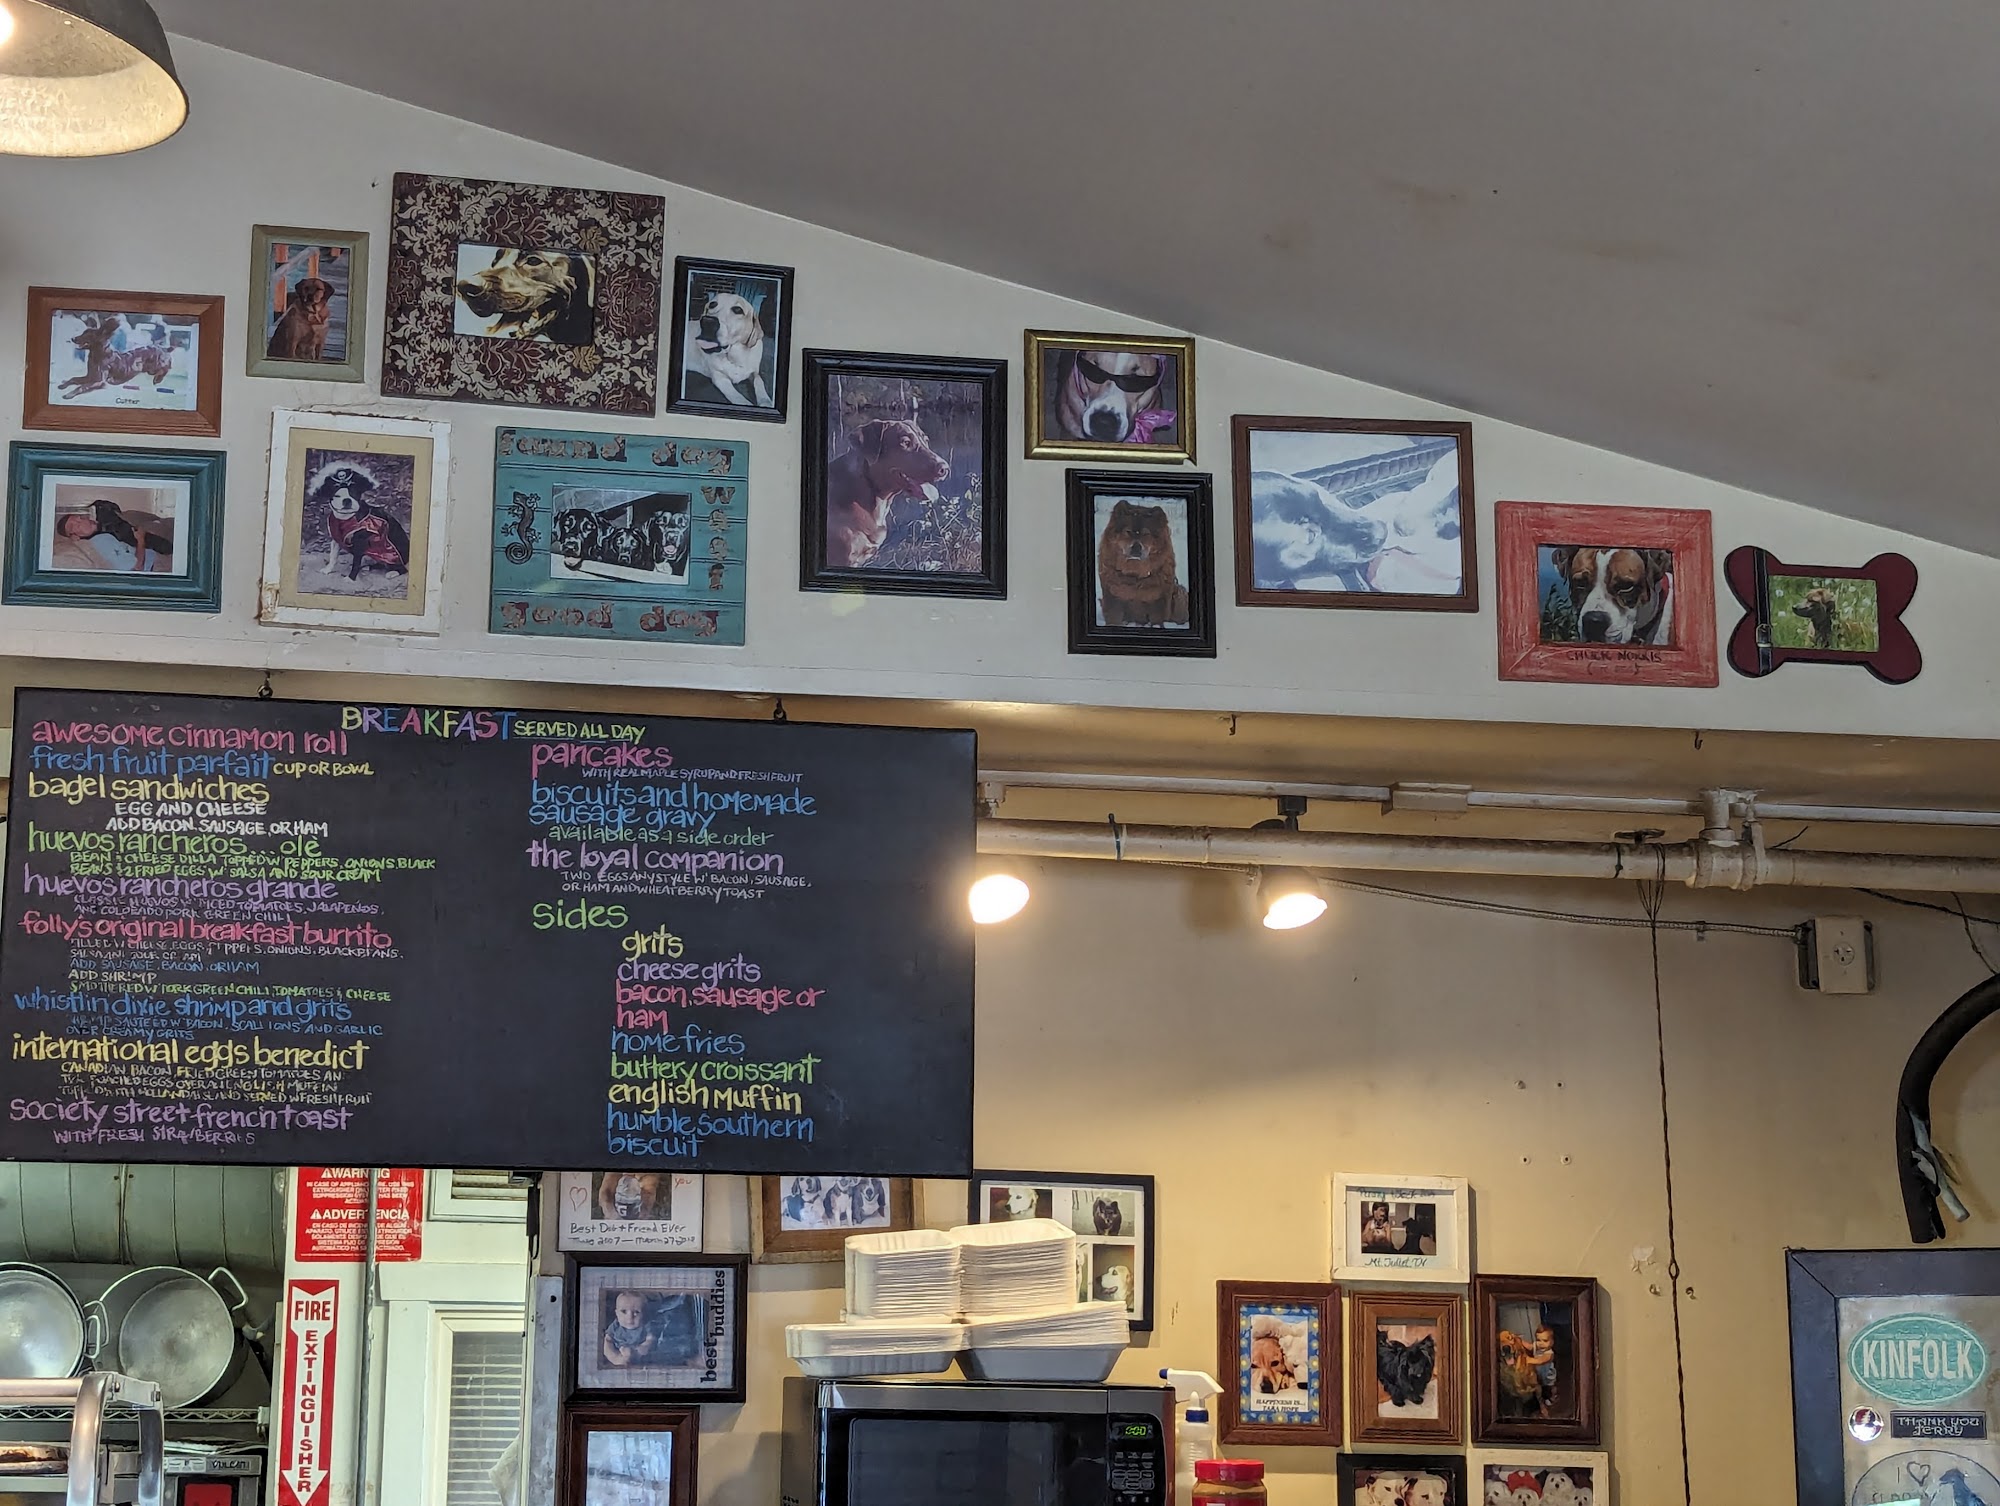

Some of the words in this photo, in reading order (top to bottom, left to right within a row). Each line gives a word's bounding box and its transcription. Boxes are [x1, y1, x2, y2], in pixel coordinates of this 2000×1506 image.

[652, 440, 735, 475] dog
[640, 605, 719, 636] dog
[32, 720, 165, 747] awesome
[168, 723, 294, 754] cinnamon
[304, 730, 348, 755] roll
[341, 706, 518, 742] BREAKFAST
[514, 720, 578, 737] SERVED
[580, 722, 609, 738] ALL
[610, 724, 646, 744] DAY
[30, 744, 105, 774] fresh
[108, 746, 173, 777] fruit
[177, 750, 275, 782] parfait
[273, 761, 306, 779] CUP
[309, 762, 331, 776] OR
[332, 762, 374, 777] BOWL
[531, 742, 673, 780] pancakes
[581, 767, 612, 782] WITH
[613, 768, 641, 779] REAL
[641, 768, 679, 780] MAPLE
[679, 769, 715, 782] SYRUP
[714, 770, 738, 781] AND
[738, 770, 771, 782] FRESH
[771, 771, 804, 783] FRUIT
[29, 771, 106, 806] bagel
[110, 773, 270, 805] sandwiches
[531, 780, 635, 807] biscuits
[637, 782, 688, 809] and
[693, 781, 817, 816] homemade
[115, 802, 153, 816] EGG
[156, 802, 193, 817] AND
[196, 802, 267, 818] CHEESE
[528, 804, 642, 834] sausage
[645, 807, 716, 840] gravy
[28, 821, 116, 853] huevos
[105, 817, 141, 832] ADD
[270, 820, 291, 836] OR
[293, 820, 328, 838] HAM
[549, 824, 636, 844] available
[637, 827, 660, 843] as
[662, 829, 673, 845] a
[676, 829, 721, 846] side
[723, 826, 775, 847] order
[70, 852, 112, 865] BEAN
[124, 853, 176, 865] CHEESE
[397, 858, 436, 869] BLACK
[135, 864, 171, 878] FRIED
[229, 867, 266, 879] SALSA
[269, 867, 298, 879] AND
[301, 868, 336, 881] SOUR
[525, 838, 575, 870] the
[580, 842, 639, 882] loyal
[644, 849, 785, 877] companion
[24, 862, 117, 896] huevos
[120, 873, 244, 899] rancheros
[246, 877, 339, 904] grande
[560, 882, 582, 893] OR
[583, 883, 611, 894] HAM
[611, 884, 636, 895] AND
[722, 887, 766, 900] TOAST
[597, 871, 629, 883] EGGS
[629, 871, 655, 885] ANY
[655, 872, 691, 887] STYLE
[18, 911, 93, 941] folly's
[94, 914, 184, 944] original
[190, 918, 302, 947] breakfast
[303, 920, 393, 949] burrito
[621, 923, 684, 962] grits
[68, 968, 98, 980] ADD
[617, 959, 700, 983] cheese
[701, 952, 762, 993] grits
[111, 990, 171, 1016] dixie
[174, 996, 247, 1024] shrimp
[249, 996, 293, 1018] and
[295, 996, 352, 1024] grits
[193, 982, 236, 996] GREEN
[346, 987, 392, 1002] CHEESE
[692, 985, 795, 1015] sausage
[795, 986, 827, 1008] or
[304, 1022, 332, 1035] AND
[616, 1003, 669, 1035] ham
[12, 1030, 179, 1064] international
[184, 1038, 250, 1072] eggs
[254, 1035, 370, 1071] benedict
[610, 1026, 676, 1055] home
[678, 1023, 746, 1056] fries
[610, 1050, 699, 1088] buttery
[700, 1052, 822, 1085] croissant
[608, 1077, 710, 1116] english
[712, 1083, 802, 1116] muffin
[113, 1098, 190, 1125] street
[189, 1103, 278, 1130] french
[278, 1103, 354, 1131] toast
[606, 1101, 697, 1136] humble
[696, 1110, 815, 1143] southern
[54, 1129, 94, 1144] WITH
[606, 1130, 705, 1159] biscuit
[570, 1222, 597, 1234] Best
[627, 1222, 659, 1234] Friend
[294, 1300, 331, 1321] FIRE
[710, 1269, 726, 1337] buddies
[700, 1337, 718, 1383] best
[1862, 1339, 1975, 1380] KINFOLK
[297, 1329, 319, 1493] EXTINGUISHER
[1896, 1416, 1947, 1428] THANK
[1950, 1416, 1980, 1428] YOU
[1912, 1424, 1964, 1437] JERRY
